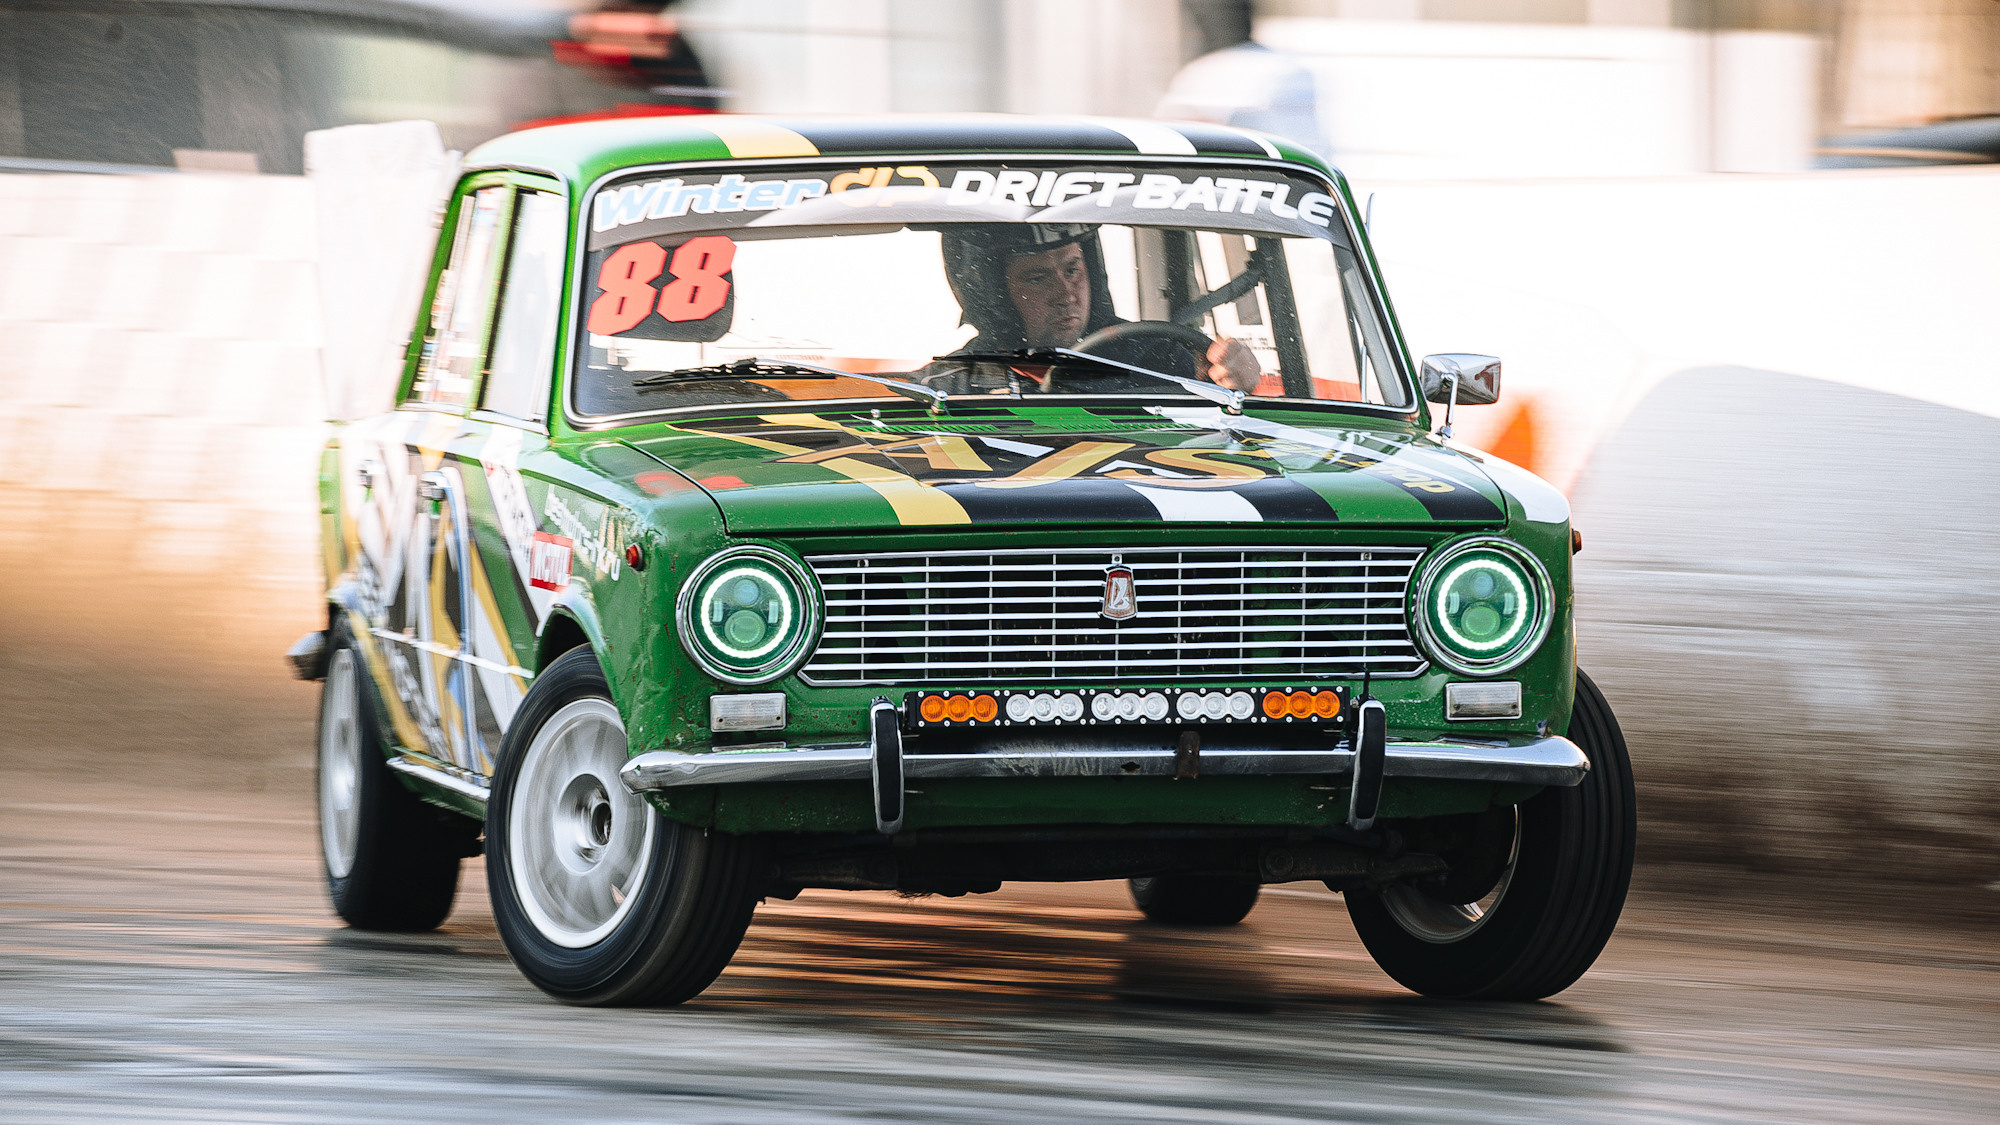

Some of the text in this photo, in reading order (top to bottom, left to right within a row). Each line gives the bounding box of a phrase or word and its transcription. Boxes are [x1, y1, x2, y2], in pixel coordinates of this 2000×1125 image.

[594, 174, 828, 232] Winter
[946, 170, 1135, 207] DRIFT
[1133, 174, 1337, 227] BATTLE
[586, 235, 738, 336] 88
